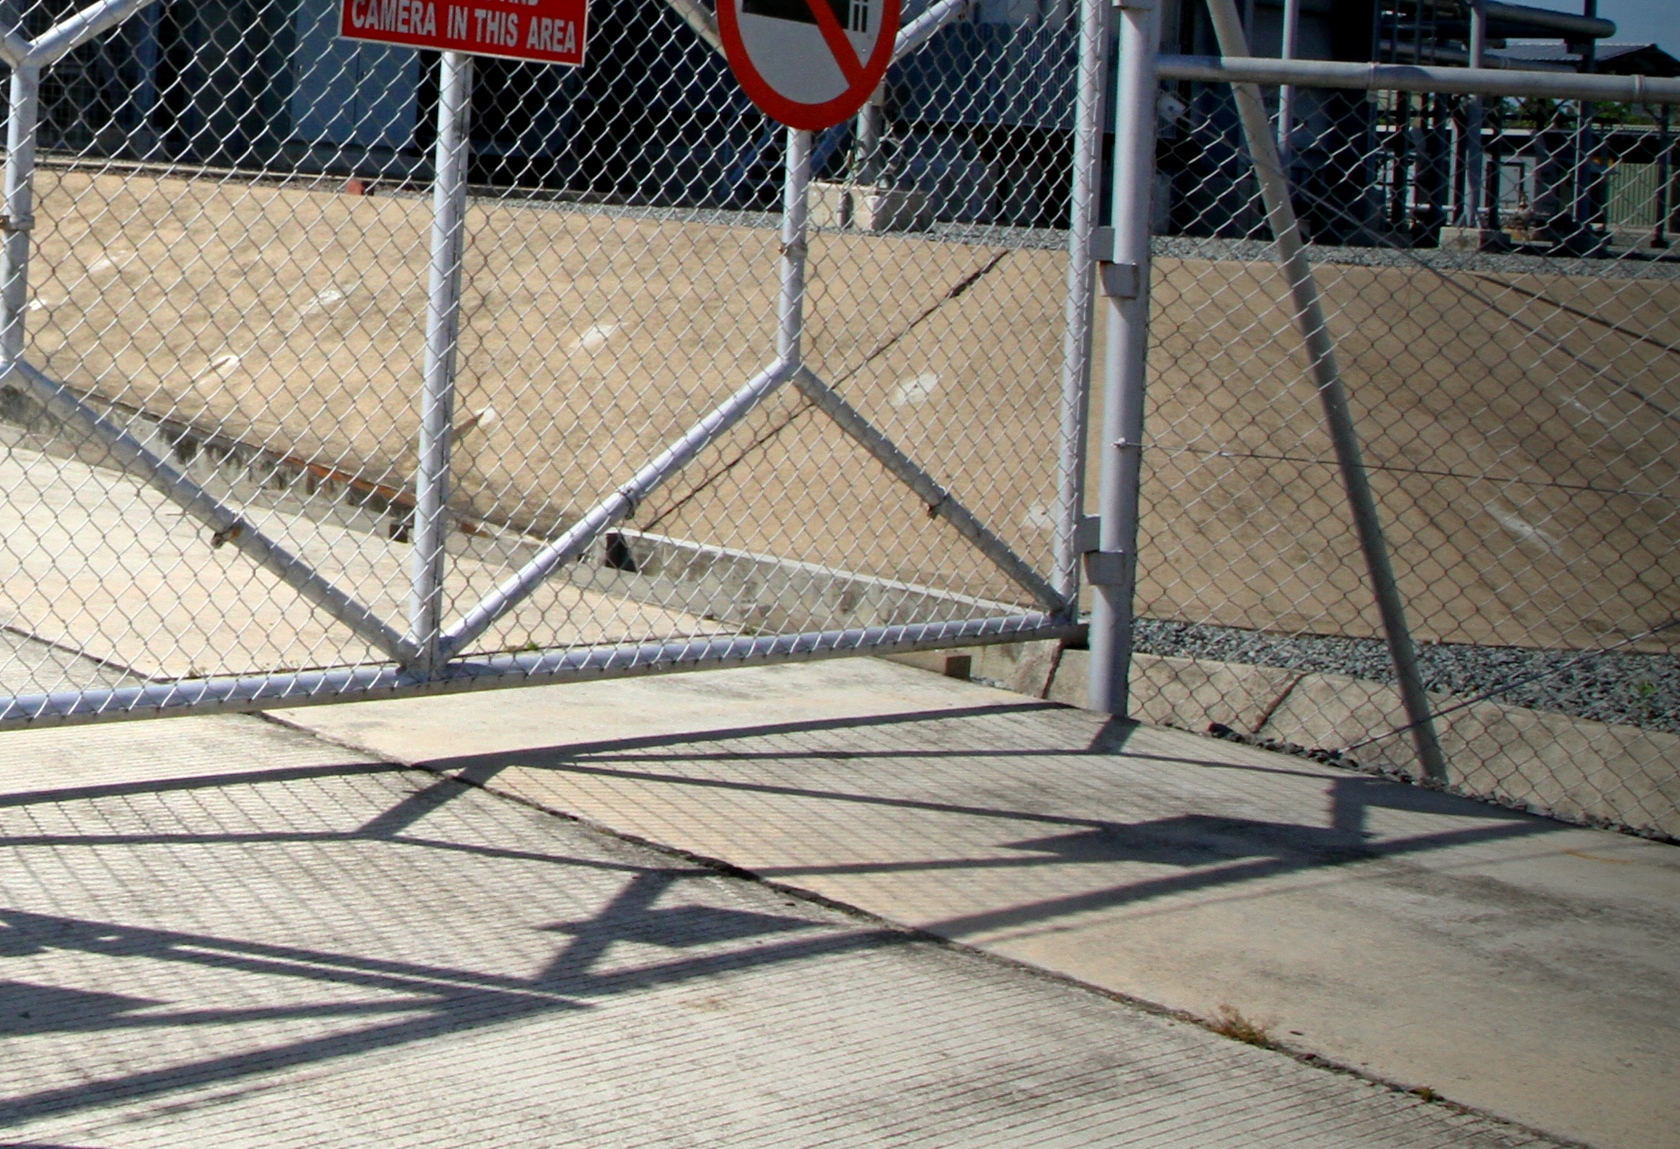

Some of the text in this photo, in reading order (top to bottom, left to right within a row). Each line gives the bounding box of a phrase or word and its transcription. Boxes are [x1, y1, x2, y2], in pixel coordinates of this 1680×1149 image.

[446, 4, 469, 40] IN
[474, 9, 519, 48] THIS
[526, 16, 576, 54] AREA
